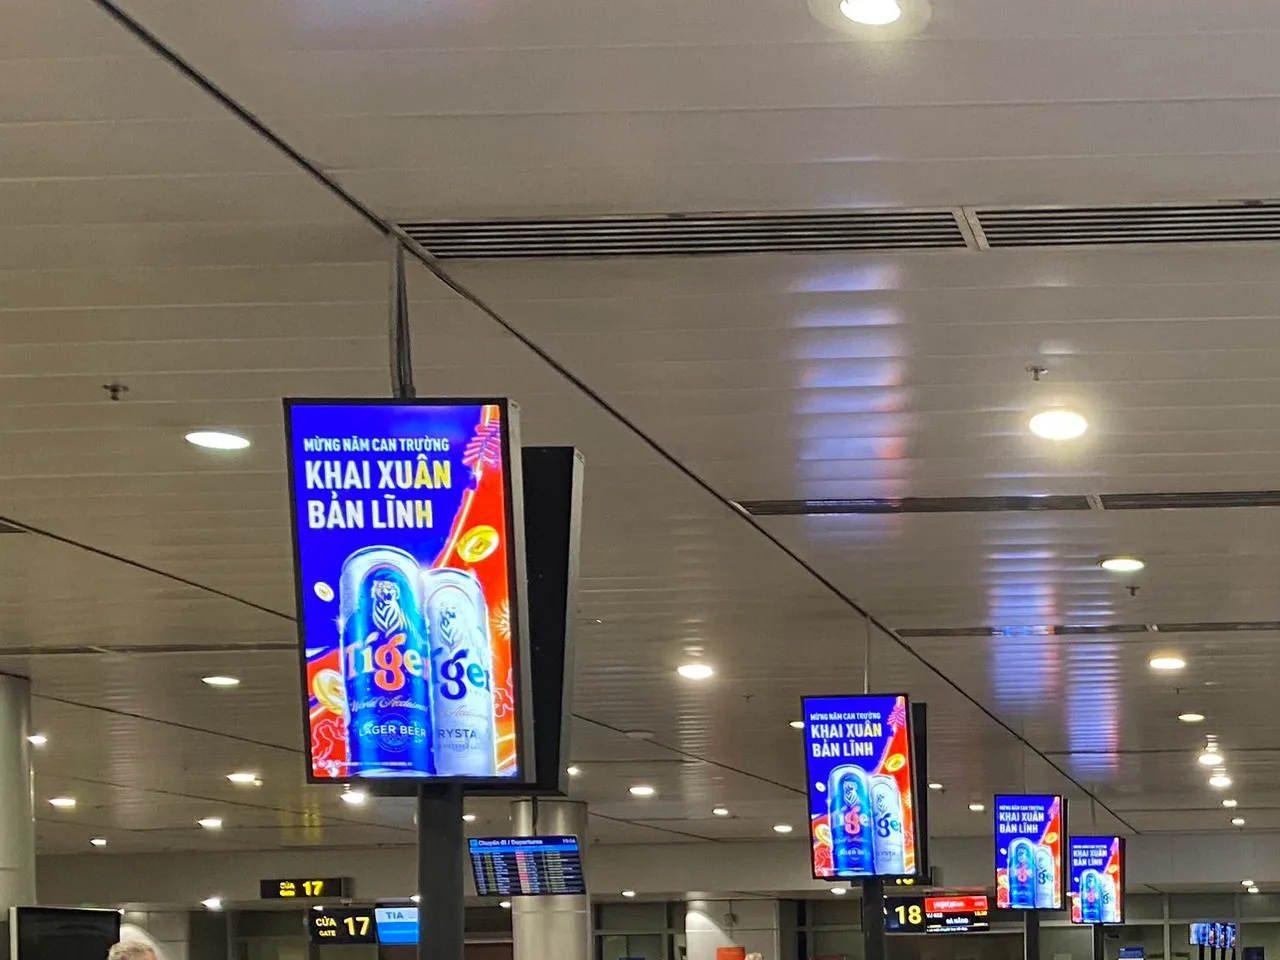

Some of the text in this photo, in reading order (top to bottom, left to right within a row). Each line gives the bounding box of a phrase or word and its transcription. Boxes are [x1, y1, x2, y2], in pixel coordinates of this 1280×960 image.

[304, 435, 450, 452] MỪNG NĂM CAN TRƯỜNG
[305, 454, 451, 489] KHAI XUÂN
[308, 490, 433, 528] BẢN LĨNH
[400, 725, 426, 737] BEER
[811, 720, 882, 738] KHAI XUÂN
[843, 739, 873, 756] LĨNH
[302, 881, 323, 896] 17
[895, 905, 922, 924] 18
[316, 915, 370, 936] CỬA 17
